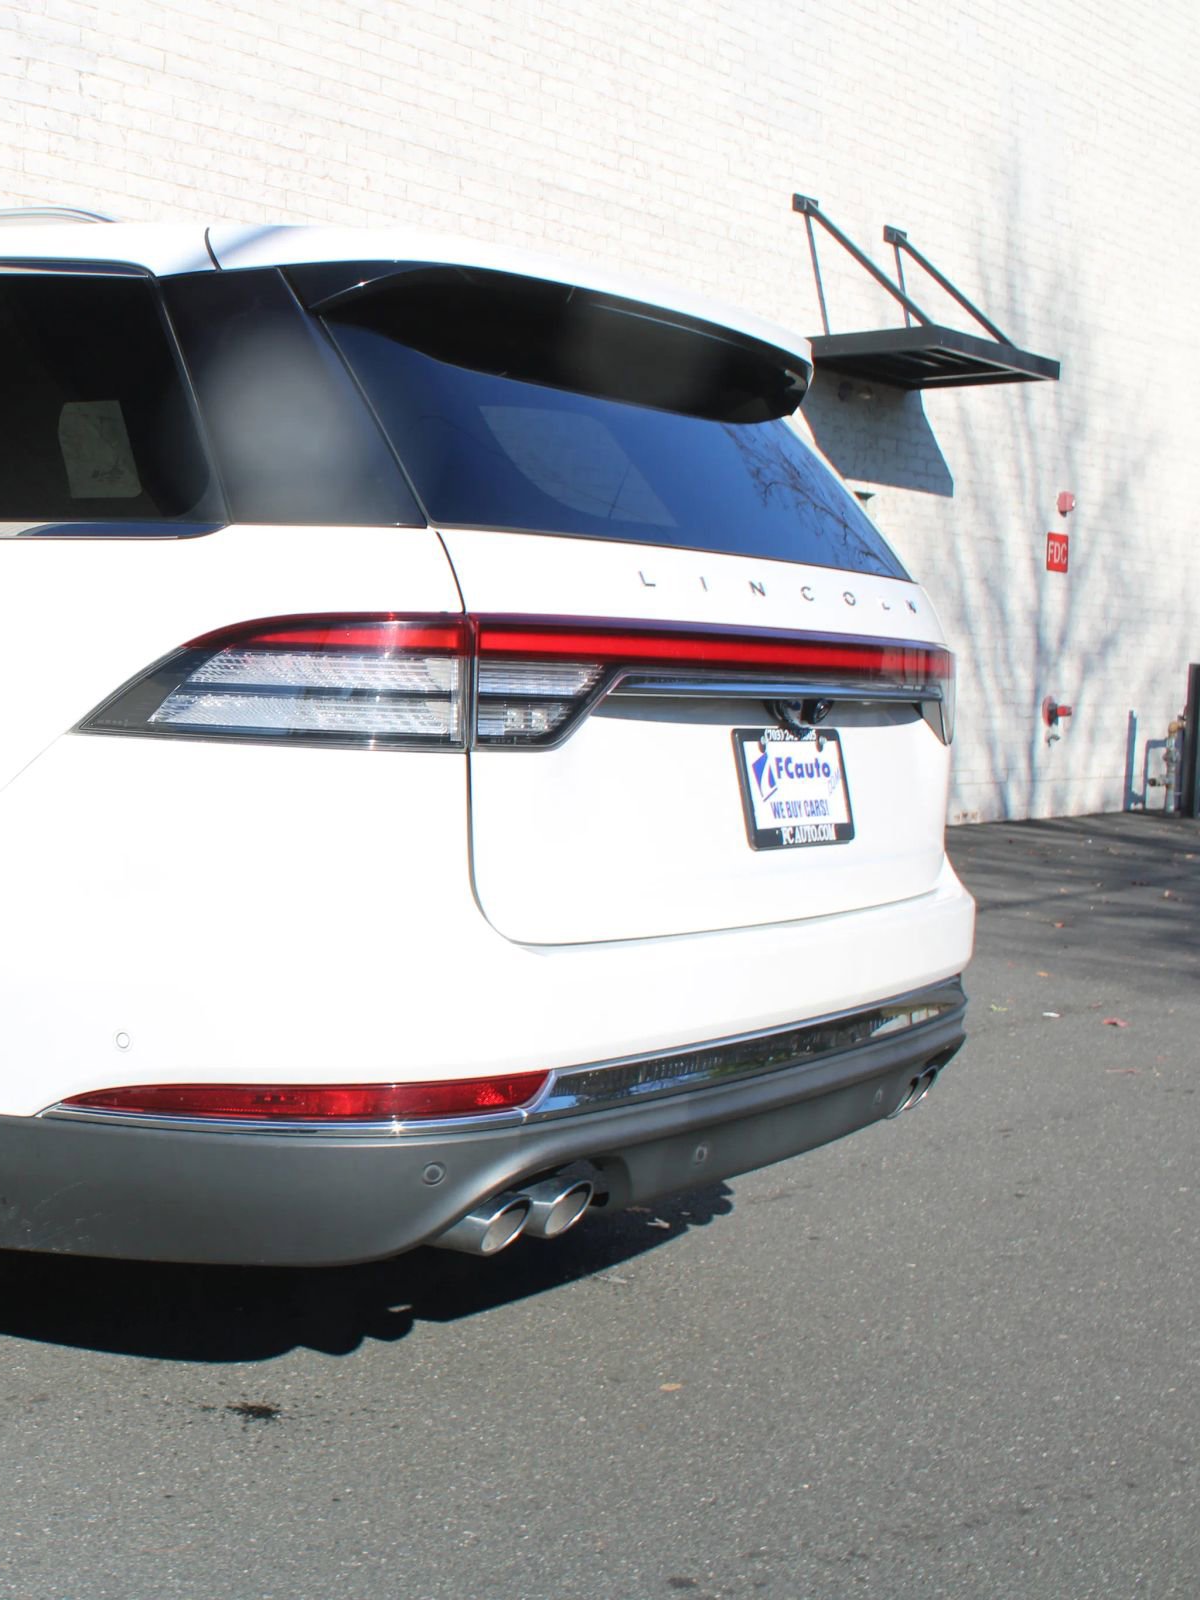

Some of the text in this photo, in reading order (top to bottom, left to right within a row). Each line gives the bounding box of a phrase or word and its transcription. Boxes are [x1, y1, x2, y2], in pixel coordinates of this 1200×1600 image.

[1048, 540, 1068, 564] FDC
[638, 570, 918, 614] LINCOLN
[775, 756, 831, 779] FCauto
[770, 799, 830, 819] WE BUY CARS!
